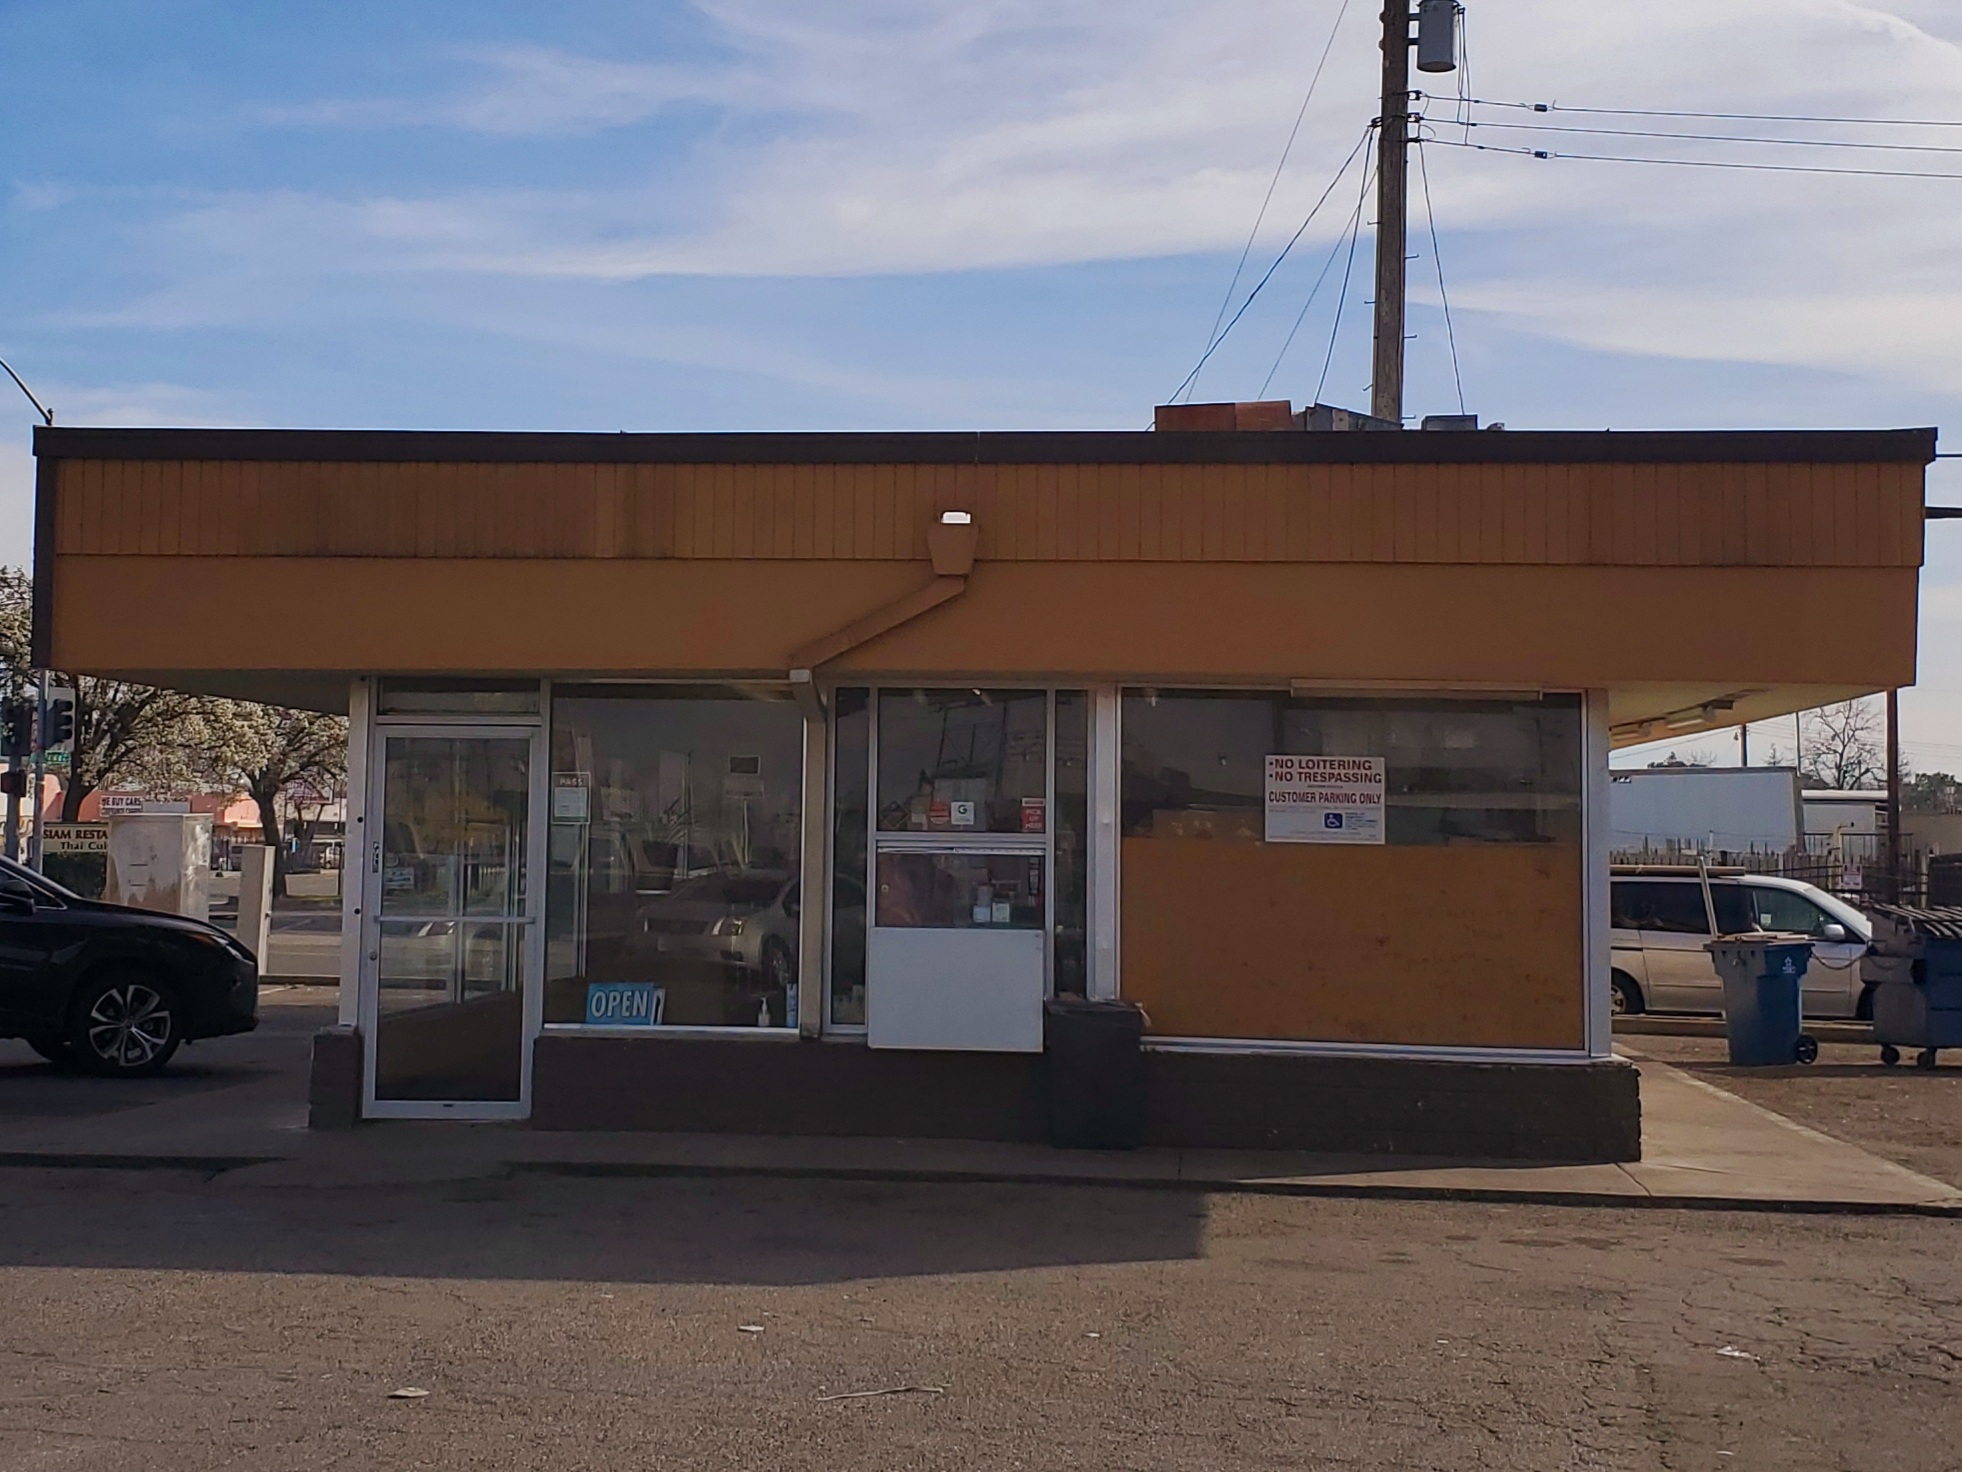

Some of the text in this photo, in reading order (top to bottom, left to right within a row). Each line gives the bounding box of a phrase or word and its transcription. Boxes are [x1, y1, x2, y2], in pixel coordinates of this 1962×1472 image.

[1274, 758, 1373, 771] NO LOITERING
[1274, 771, 1382, 784] NO TRESPASSING
[1268, 791, 1382, 805] CUSTOMER PARKING ONLY
[43, 829, 108, 840] SIAM RESTA
[60, 841, 84, 850] Thai
[591, 990, 648, 1018] OPEN
